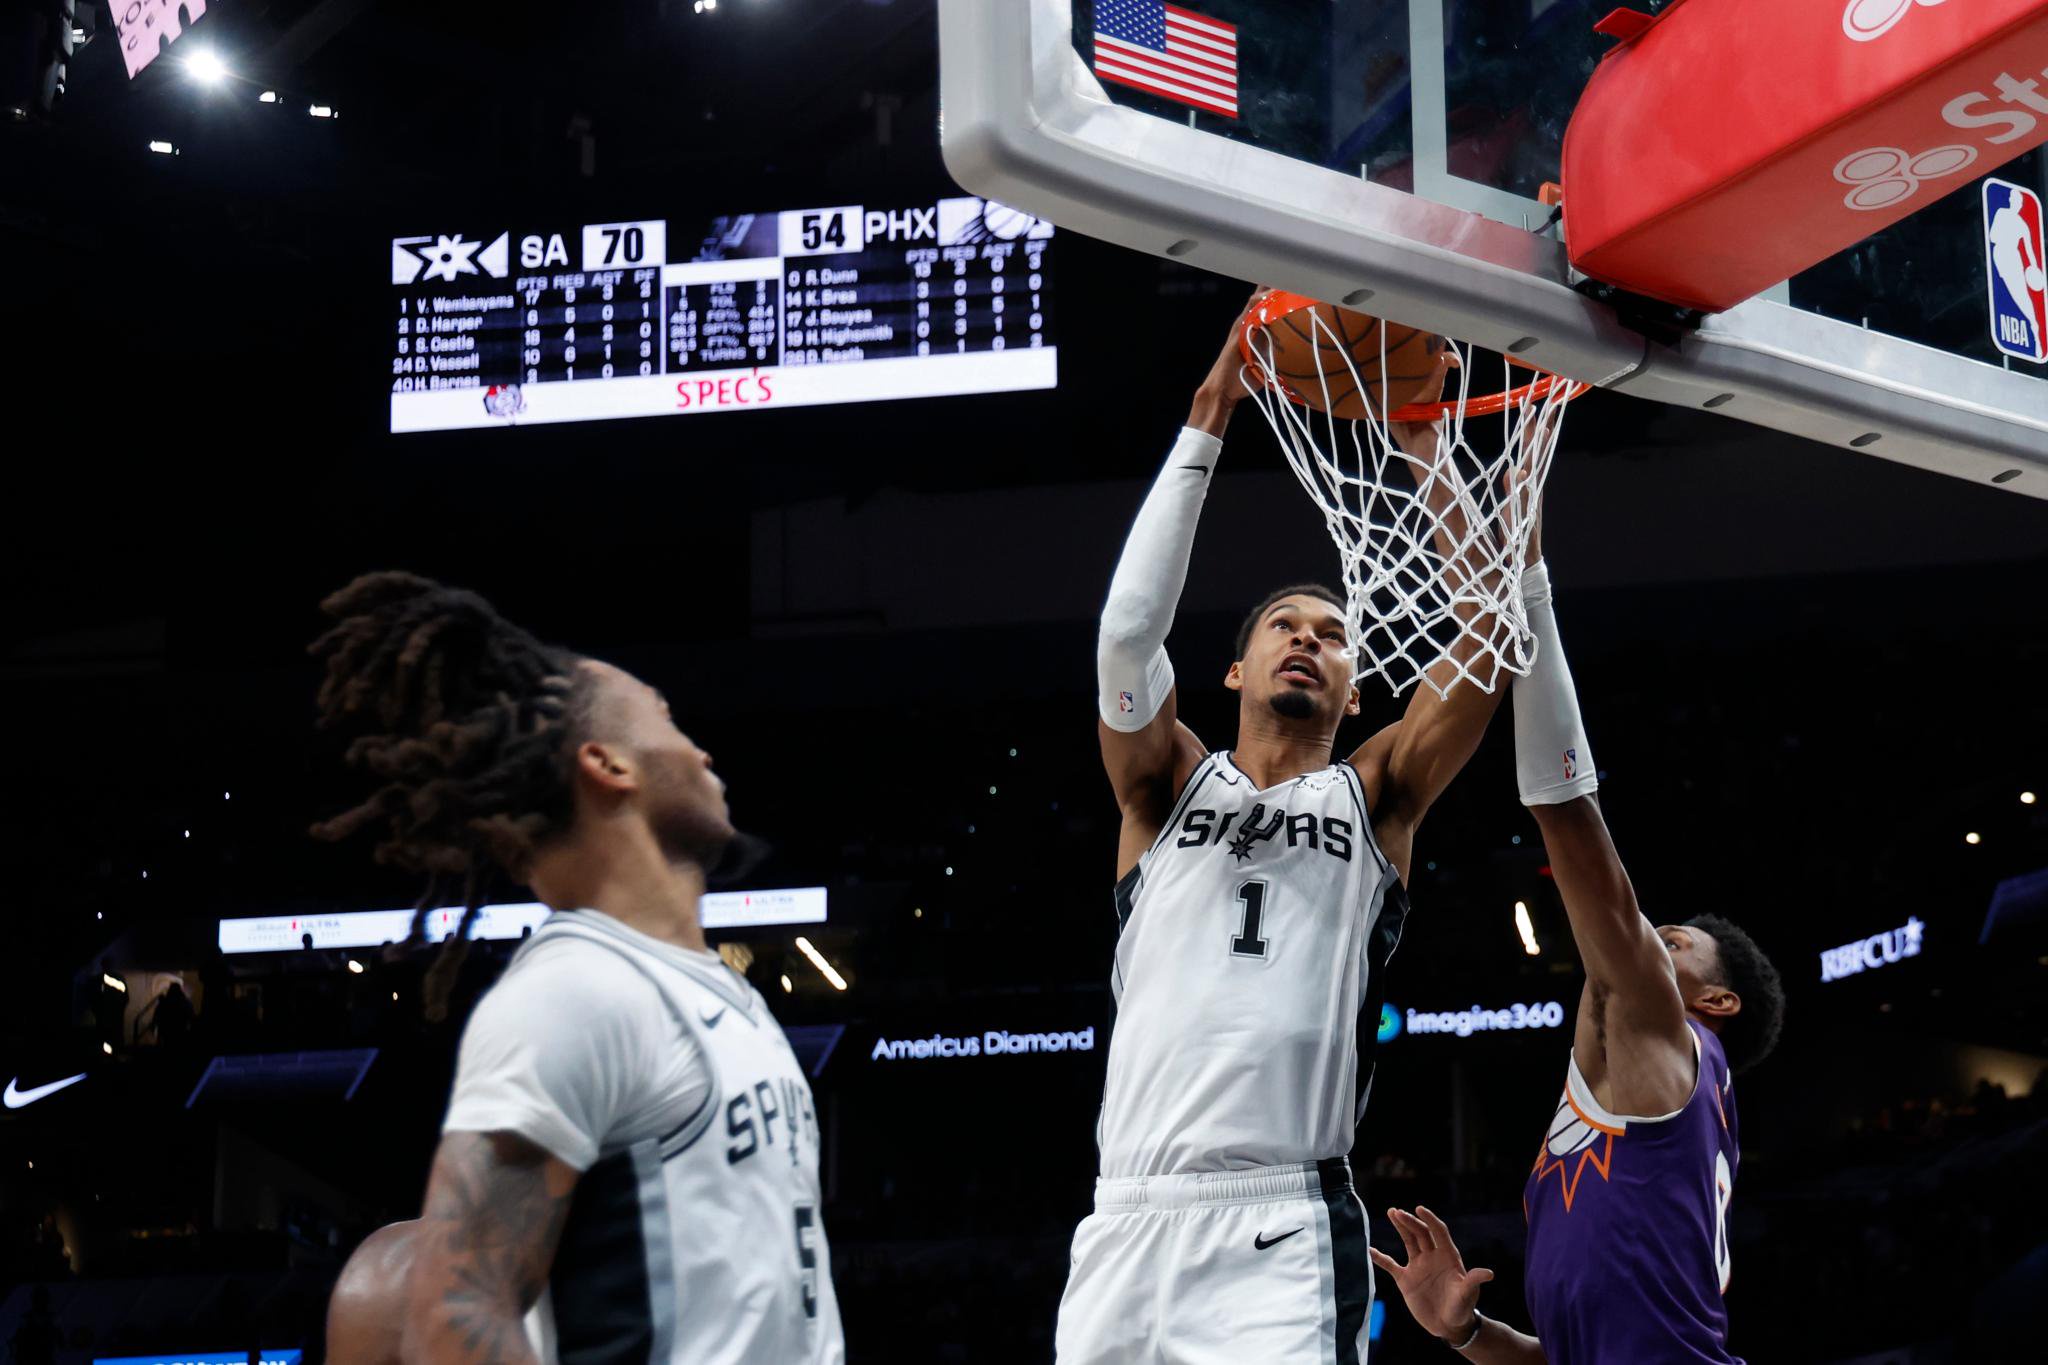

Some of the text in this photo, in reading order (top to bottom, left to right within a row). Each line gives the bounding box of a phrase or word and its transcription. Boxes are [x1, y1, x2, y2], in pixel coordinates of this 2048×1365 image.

[1941, 68, 2048, 145] St
[802, 206, 936, 249] 54 PHX
[520, 227, 644, 269] SA 70
[954, 279, 967, 296] 0
[991, 276, 1004, 293] 0
[1029, 273, 1042, 291] 0
[401, 298, 407, 314] 1
[431, 316, 483, 333] Harper
[602, 304, 614, 321] 0
[642, 302, 649, 318] 1
[1032, 294, 1040, 310] 1
[430, 334, 475, 353] Castle
[564, 327, 575, 343] 4
[639, 321, 651, 338] 0
[917, 321, 930, 338] 0
[995, 316, 1003, 332] 1
[1029, 313, 1042, 330] 0
[2000, 314, 2030, 348] NBA
[392, 357, 413, 374] 24
[430, 352, 480, 372] Vassell
[524, 349, 540, 365] 10
[605, 344, 611, 360] 1
[392, 377, 414, 392] 40
[567, 366, 573, 382] 1
[677, 367, 772, 408] SPEC'S
[1228, 879, 1270, 960] 1
[1406, 1001, 1564, 1038] imagine360
[871, 1026, 1095, 1061] Americus Diamond
